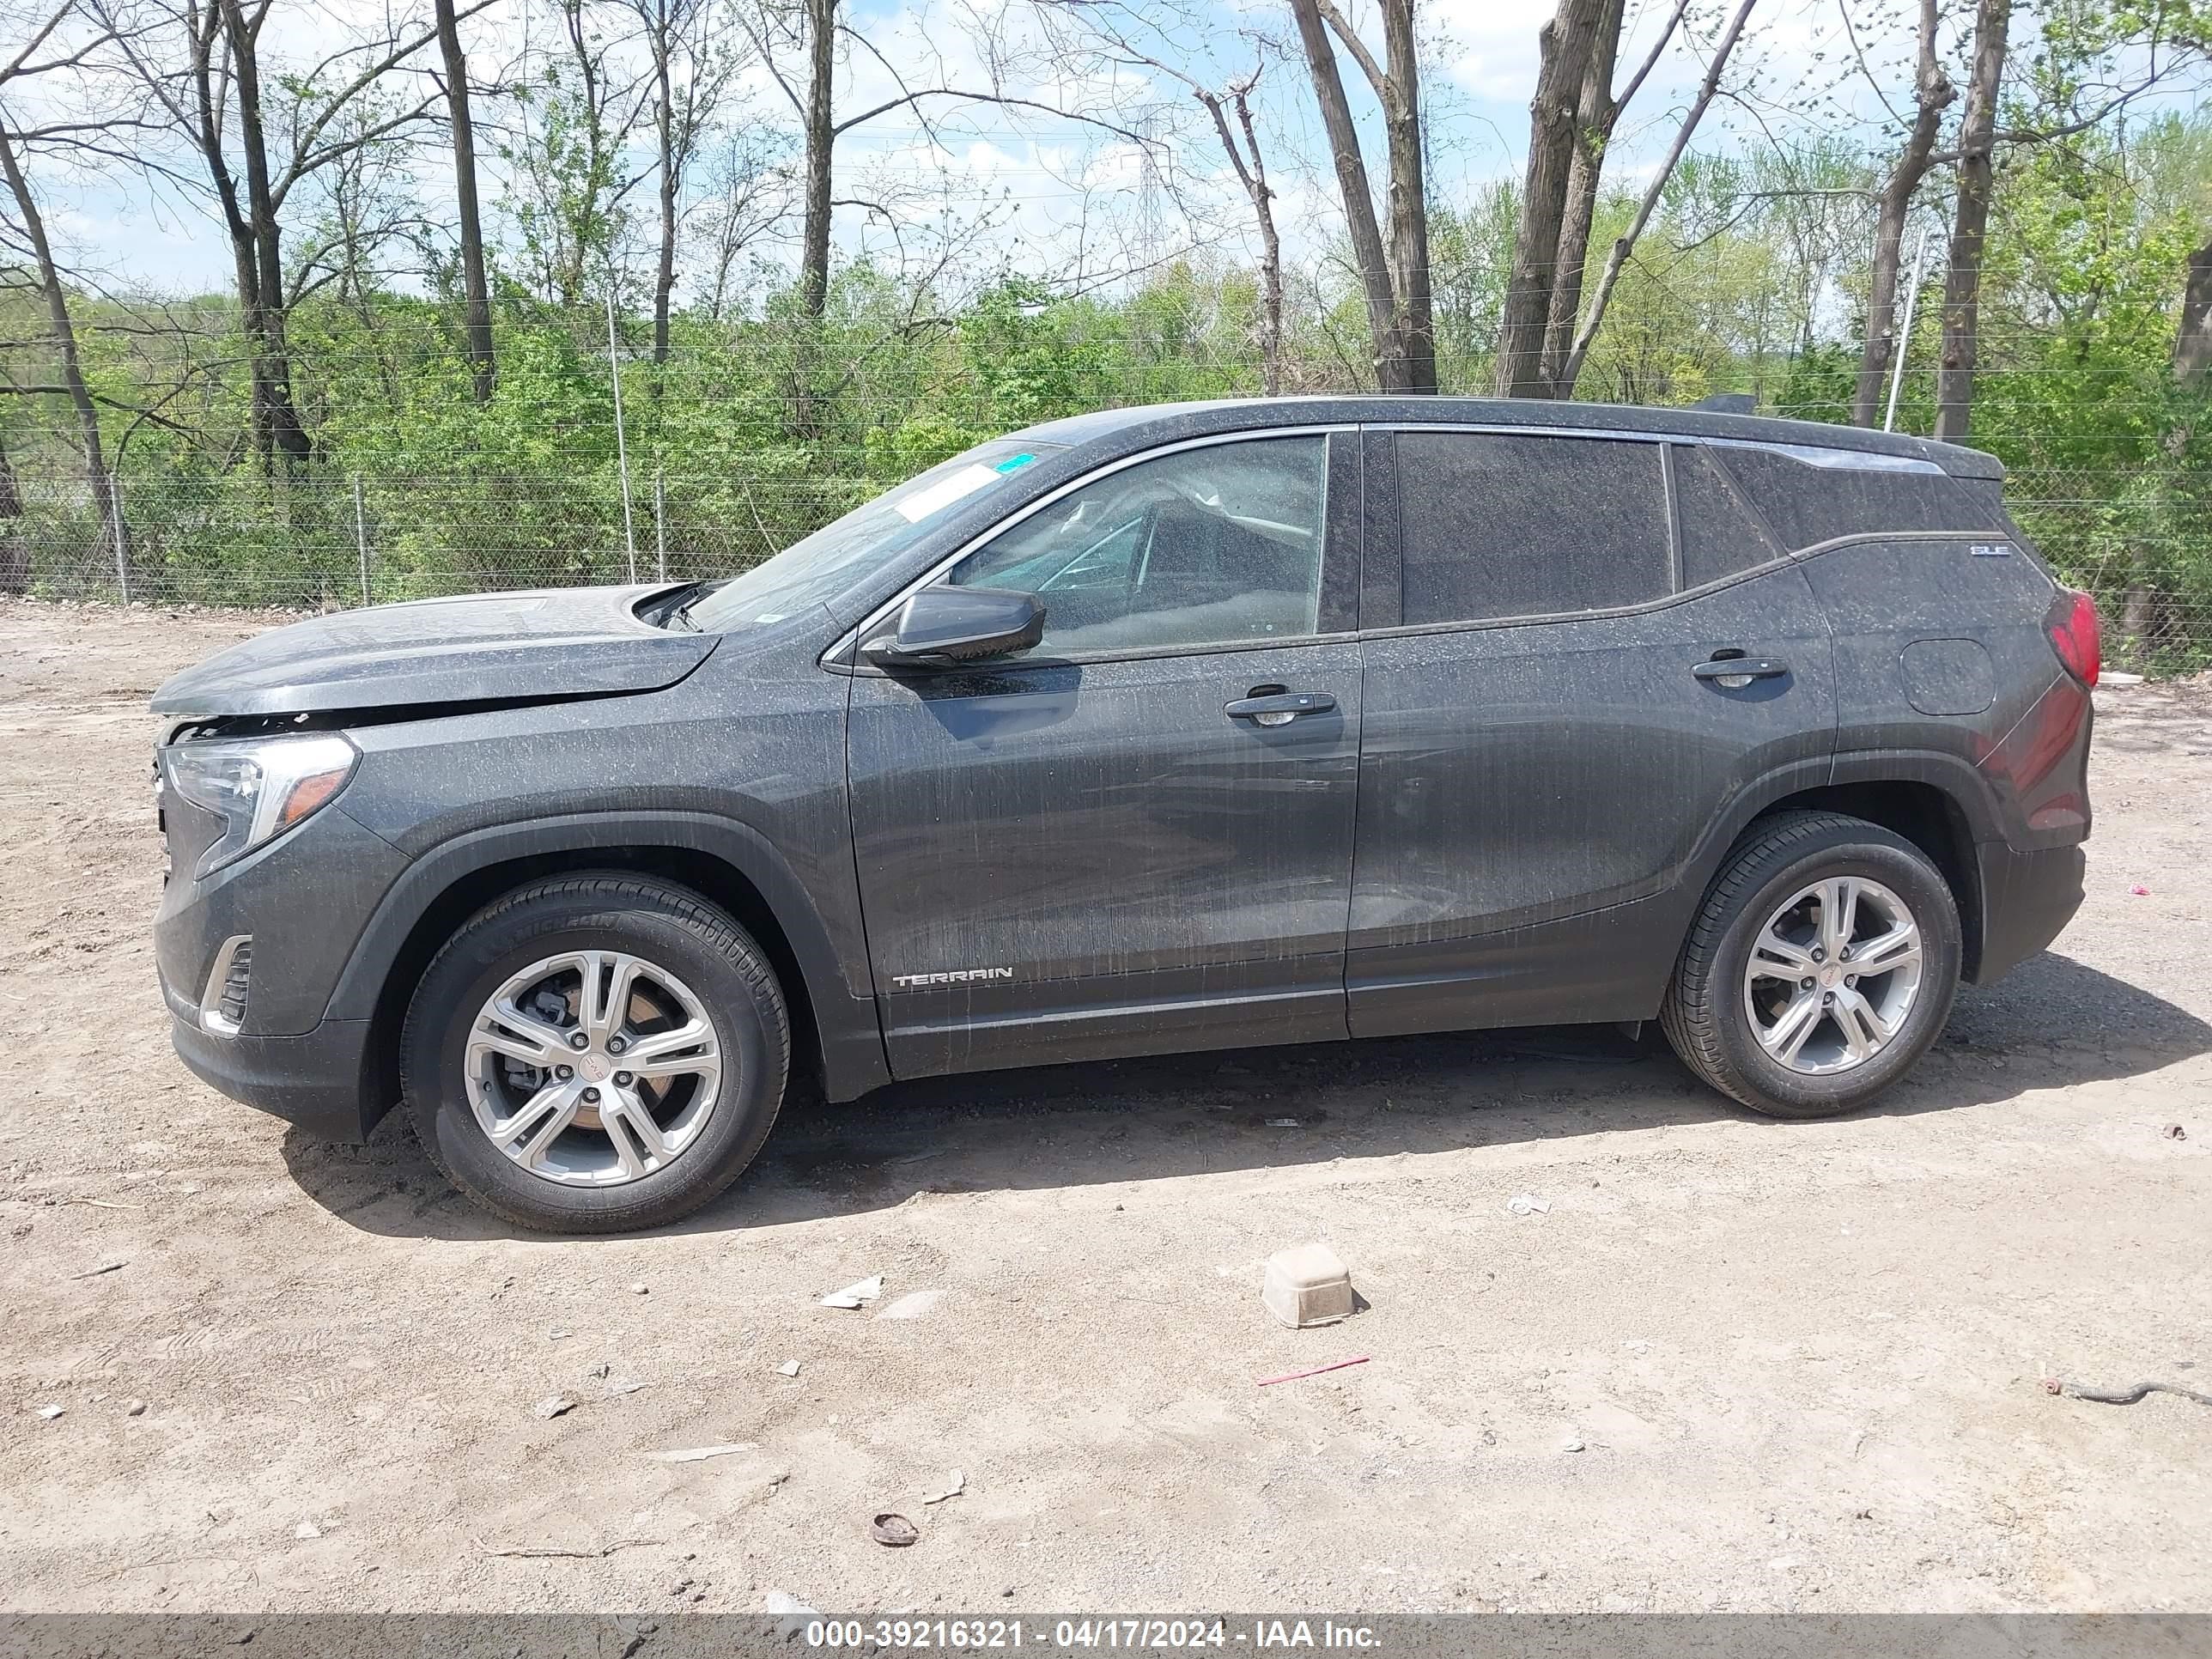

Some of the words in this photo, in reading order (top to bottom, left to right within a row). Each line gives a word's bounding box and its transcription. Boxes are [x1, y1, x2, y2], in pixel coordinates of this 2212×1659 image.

[1970, 545, 2011, 556] SLE
[892, 967, 1013, 988] TERRAIN
[585, 1057, 605, 1079] GMC
